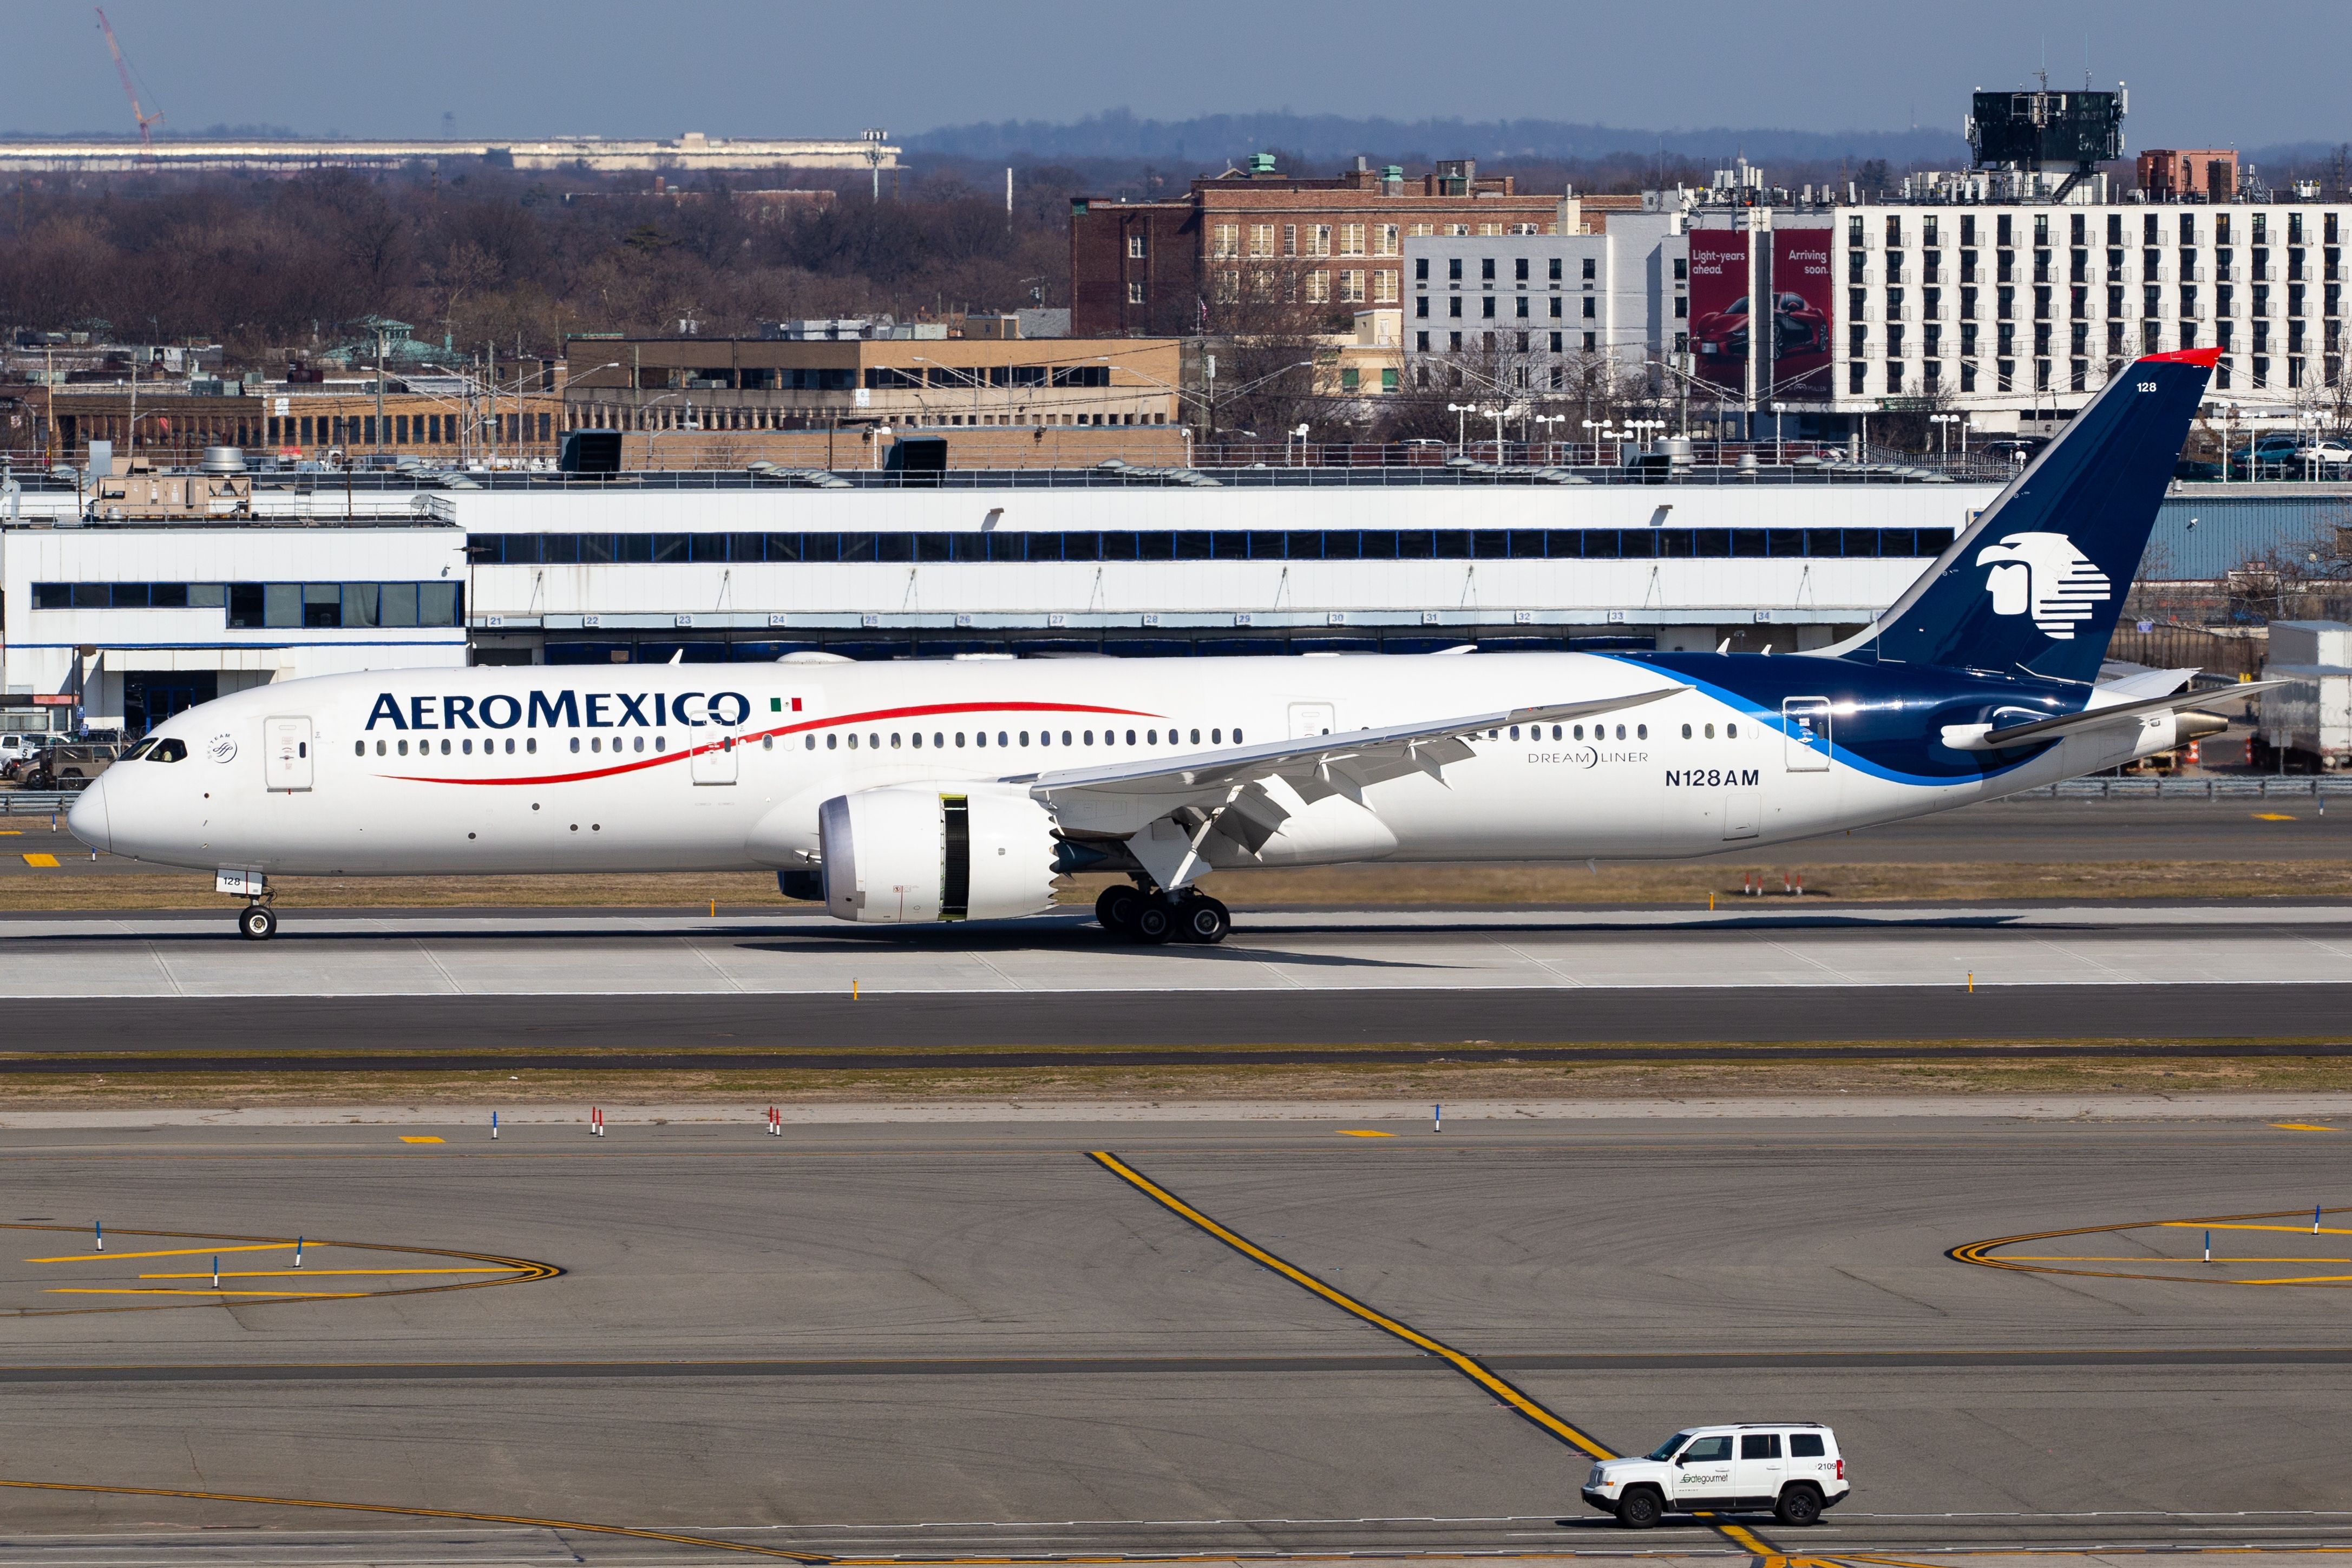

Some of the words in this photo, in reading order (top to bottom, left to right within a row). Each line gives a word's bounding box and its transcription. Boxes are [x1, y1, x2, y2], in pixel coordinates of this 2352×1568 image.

[1693, 250, 1745, 264] Light-years
[1788, 250, 1827, 264] Arriving
[1693, 264, 1722, 274] ahead.
[1804, 266, 1829, 274] soon.
[2136, 382, 2157, 392] 128
[679, 616, 691, 624] 23
[866, 616, 877, 624] 25
[1052, 615, 1064, 624] 27
[1758, 612, 1769, 620] 34
[365, 690, 751, 731] AEROMEXICO
[207, 733, 230, 759] SKYTEAM
[22, 748, 28, 757] 5
[1666, 769, 1759, 787] N128AM
[224, 877, 240, 886] 128
[1680, 1473, 1728, 1485] Gategourmet
